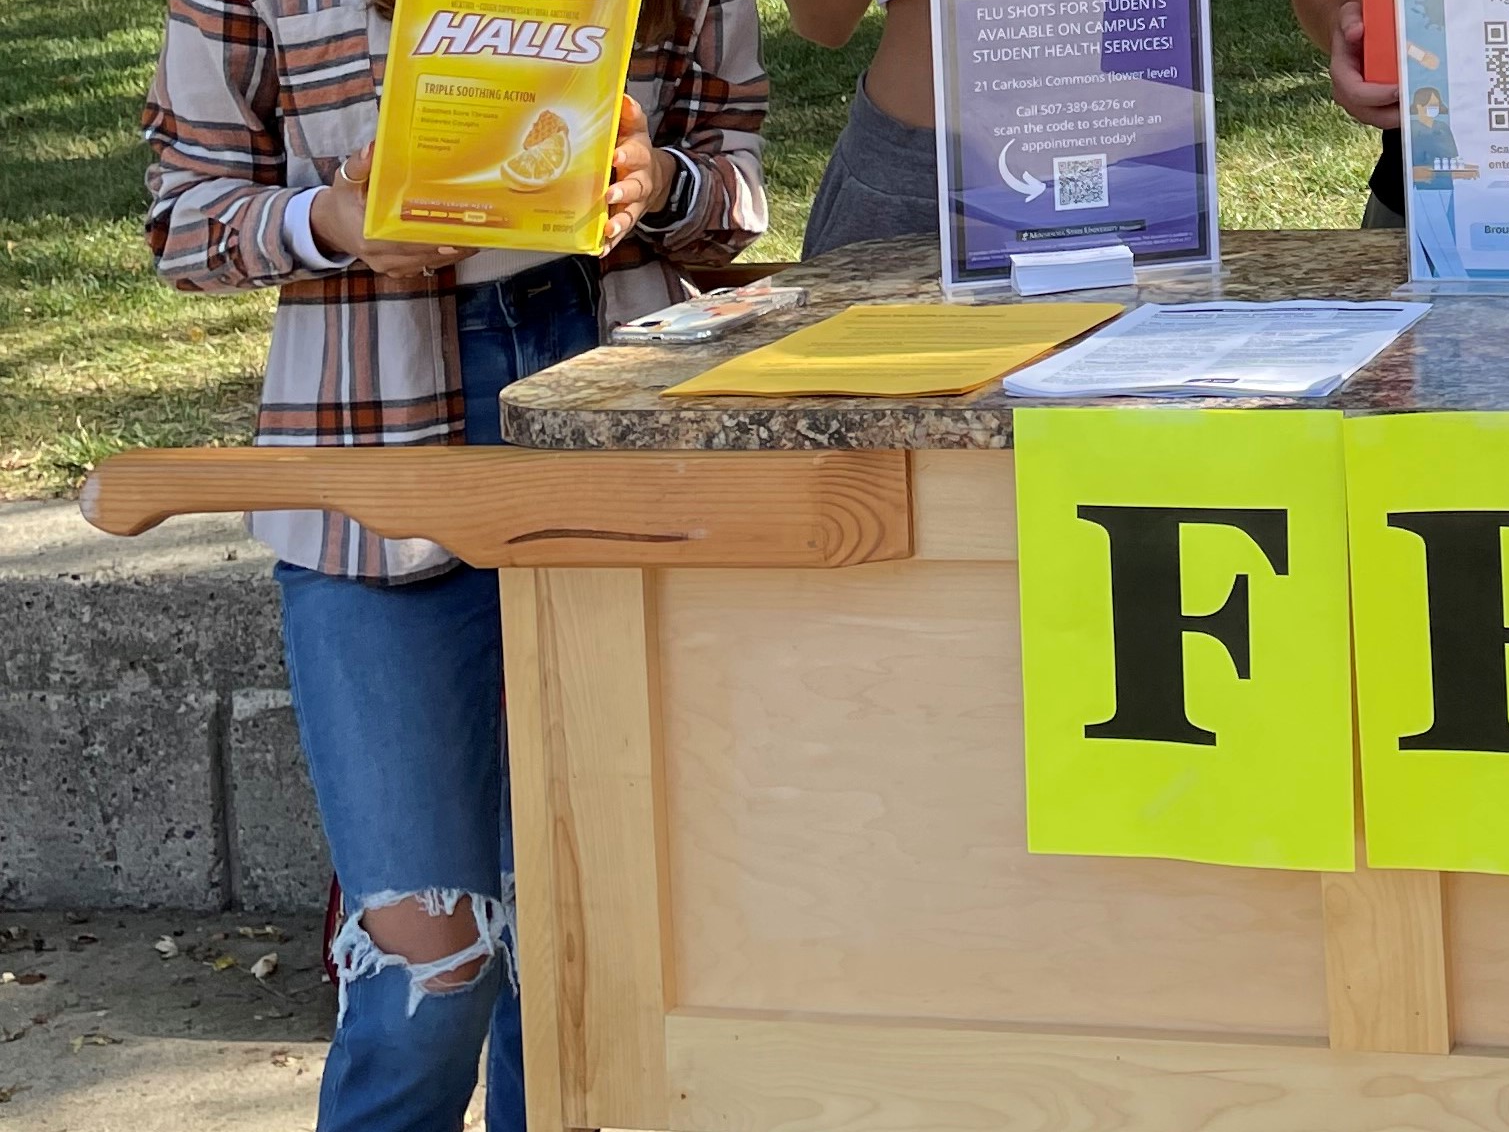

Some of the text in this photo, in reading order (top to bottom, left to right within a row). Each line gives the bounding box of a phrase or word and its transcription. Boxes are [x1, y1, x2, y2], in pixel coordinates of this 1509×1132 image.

[977, 8, 1003, 20] FLU
[1007, 4, 1056, 18] SHOTS
[1060, 2, 1089, 14] FOR
[412, 10, 609, 64] HALLS
[978, 16, 1168, 42] AVAILABLE ON CAMPUS AT
[973, 37, 1174, 64] STUDENT HEALTH SERVICES!
[974, 66, 1178, 92] 21 Carkoski Commons (lower level)
[424, 82, 536, 104] TRIPLE SOOTHING ACTION
[1016, 99, 1136, 118] Call 507-389-6276 or
[994, 114, 1162, 137] scan the code to schedule an
[1022, 132, 1136, 153] appointment today!
